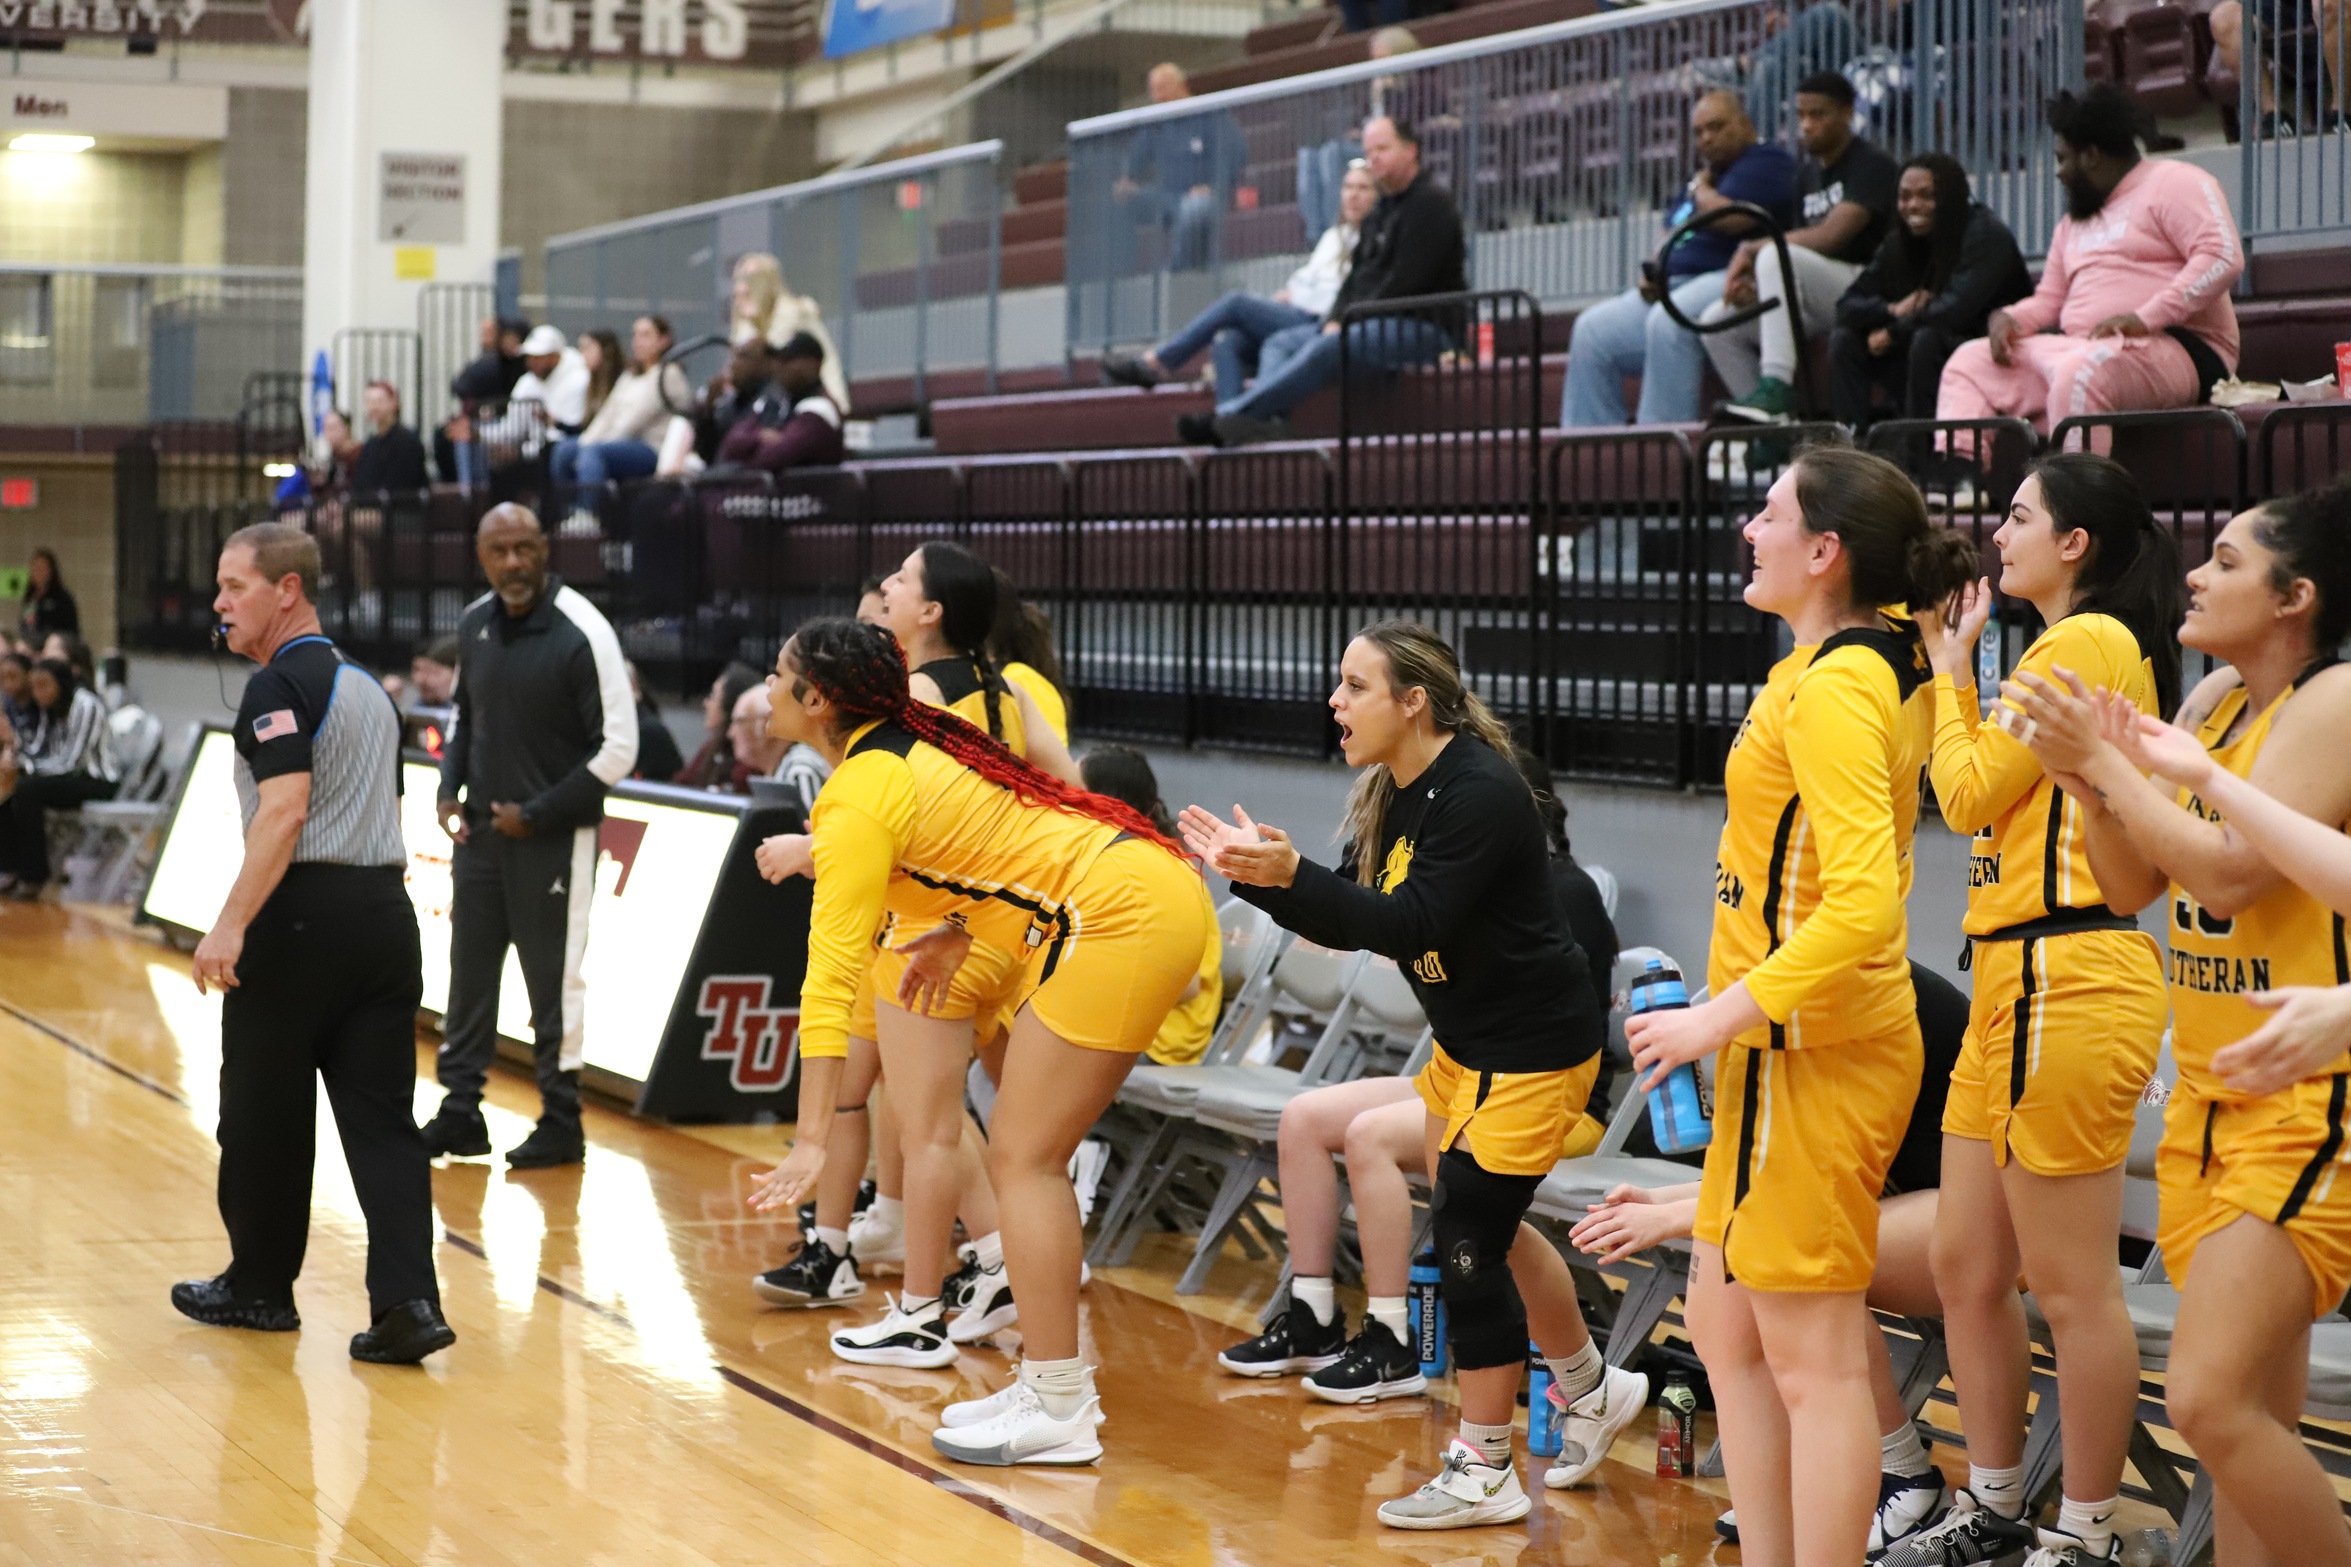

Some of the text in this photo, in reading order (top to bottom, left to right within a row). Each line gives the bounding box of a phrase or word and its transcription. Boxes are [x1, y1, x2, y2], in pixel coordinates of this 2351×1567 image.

[14, 95, 68, 117] Men
[1982, 629, 1997, 681] core
[696, 975, 800, 1093] TU
[1422, 1286, 1435, 1360] POWERADE
